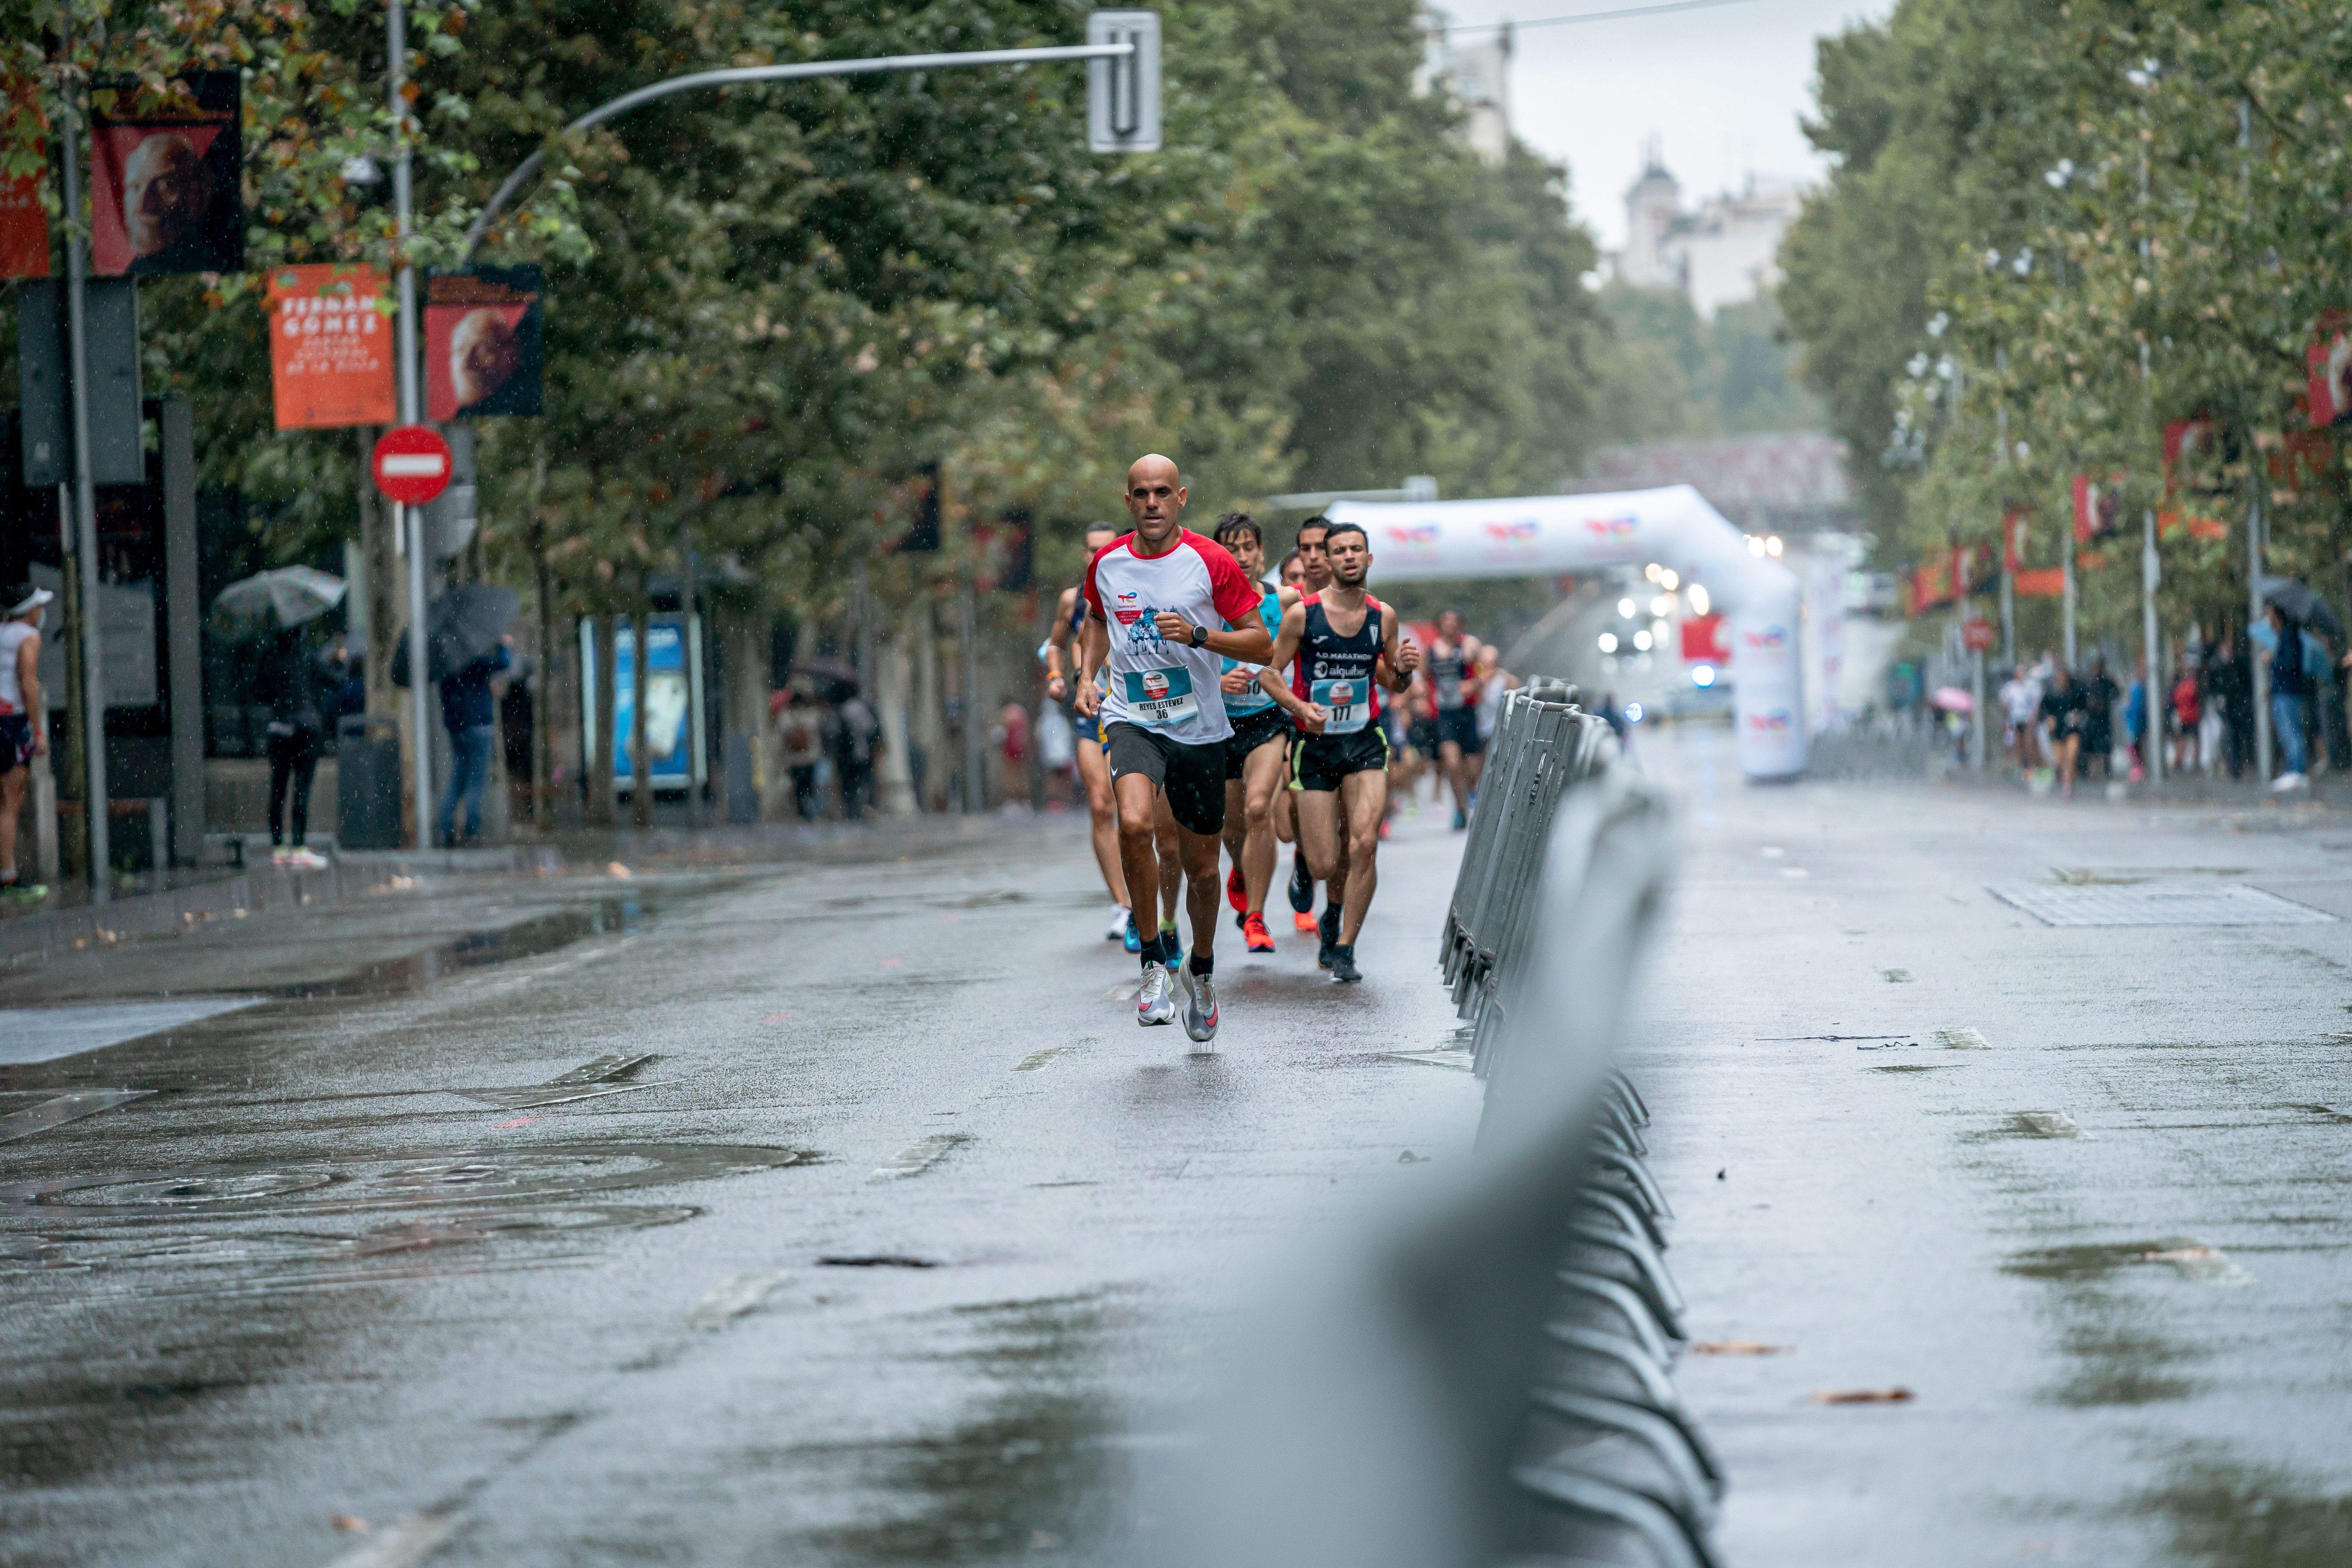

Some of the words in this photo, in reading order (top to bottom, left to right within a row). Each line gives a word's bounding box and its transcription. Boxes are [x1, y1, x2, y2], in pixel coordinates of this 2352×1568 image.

[1139, 702, 1156, 711] REYES
[1158, 697, 1183, 709] ESTÉVEZ
[1156, 709, 1168, 719] 36
[1332, 706, 1352, 721] 177
